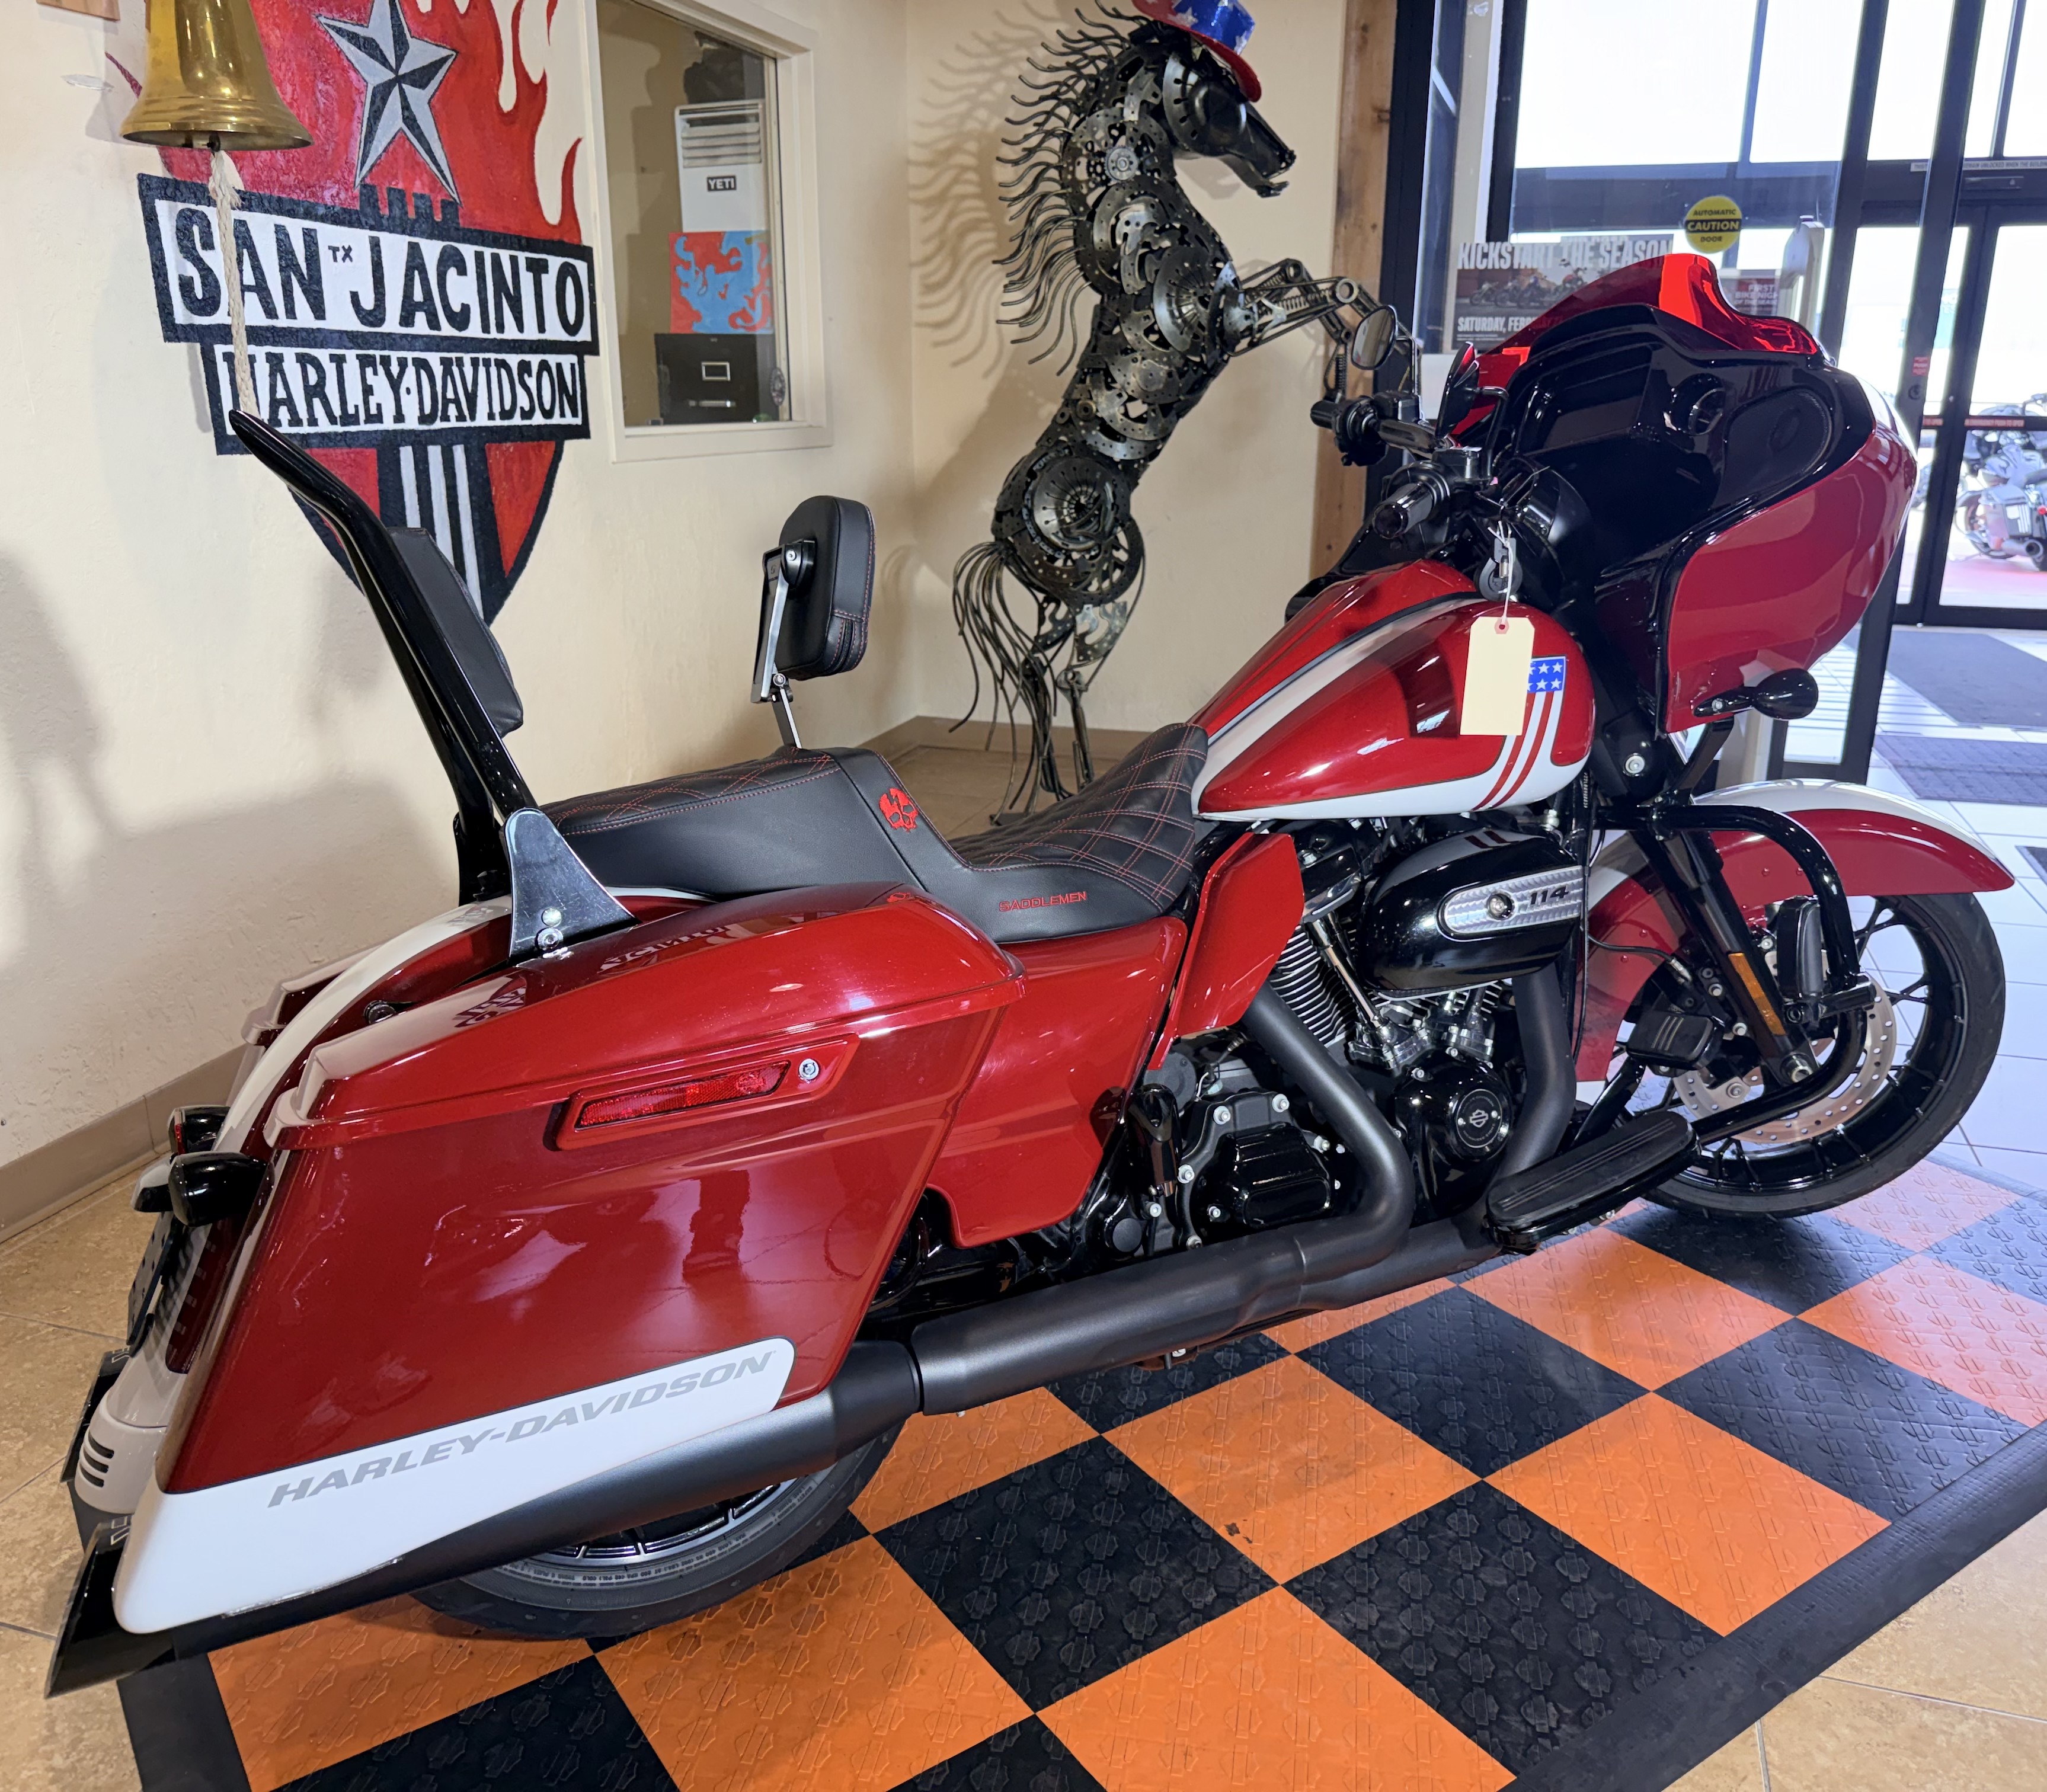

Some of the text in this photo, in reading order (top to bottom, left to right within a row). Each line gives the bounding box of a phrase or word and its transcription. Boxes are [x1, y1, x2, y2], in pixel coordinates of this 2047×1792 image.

[708, 177, 735, 190] YETI
[1687, 220, 1739, 231] CAUTION
[1458, 241, 1555, 270] KICKSTART
[1599, 239, 1672, 268] SEASON
[175, 207, 585, 337] SAN TX JACINTO
[1457, 316, 1506, 333] SATURDAY,
[999, 891, 1087, 912] SADDLEMEN
[1530, 885, 1569, 905] 114
[267, 1351, 773, 1509] HARLEY-DAVIDSON
